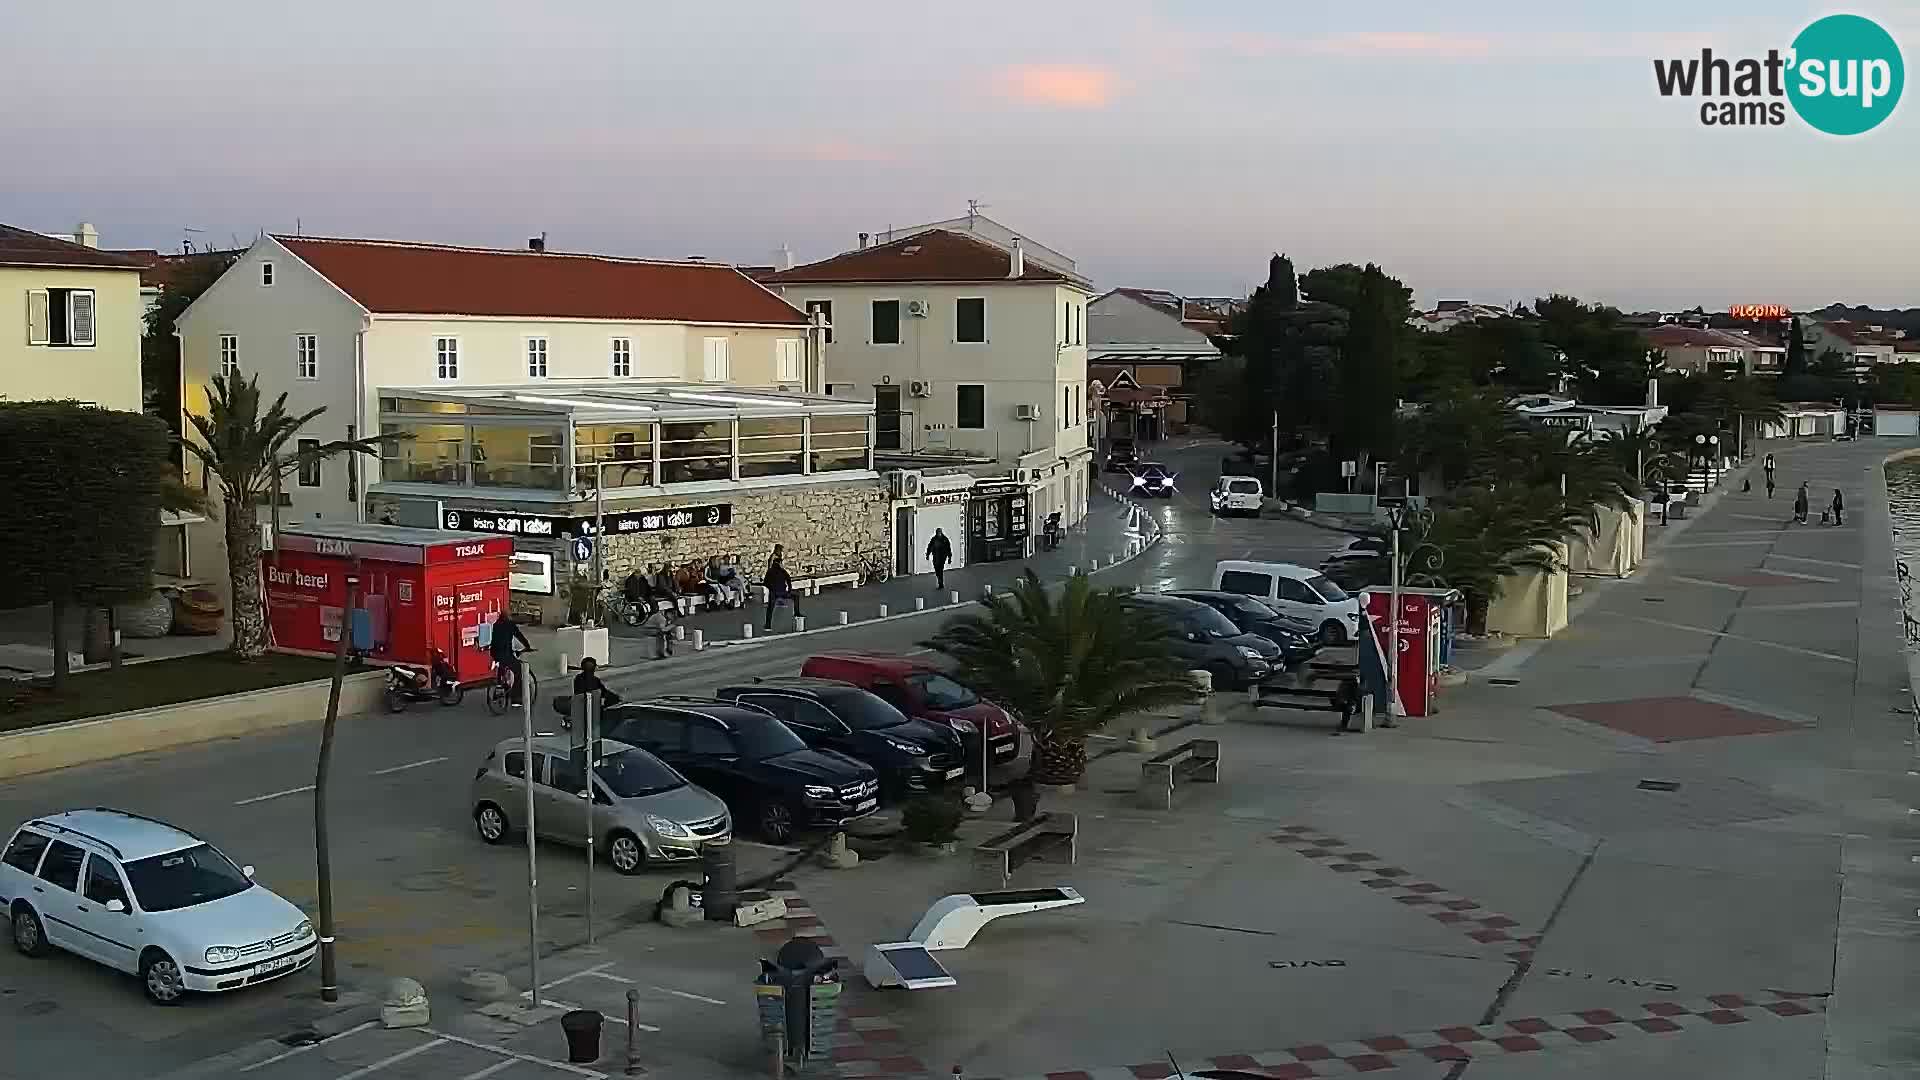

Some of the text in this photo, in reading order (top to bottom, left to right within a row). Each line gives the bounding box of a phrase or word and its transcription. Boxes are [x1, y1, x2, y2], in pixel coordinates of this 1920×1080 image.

[926, 494, 961, 505] MARKET
[315, 538, 352, 555] TISAK
[456, 544, 485, 557] TISAK
[268, 566, 328, 589] Buy here!
[436, 589, 483, 607] Buy here!
